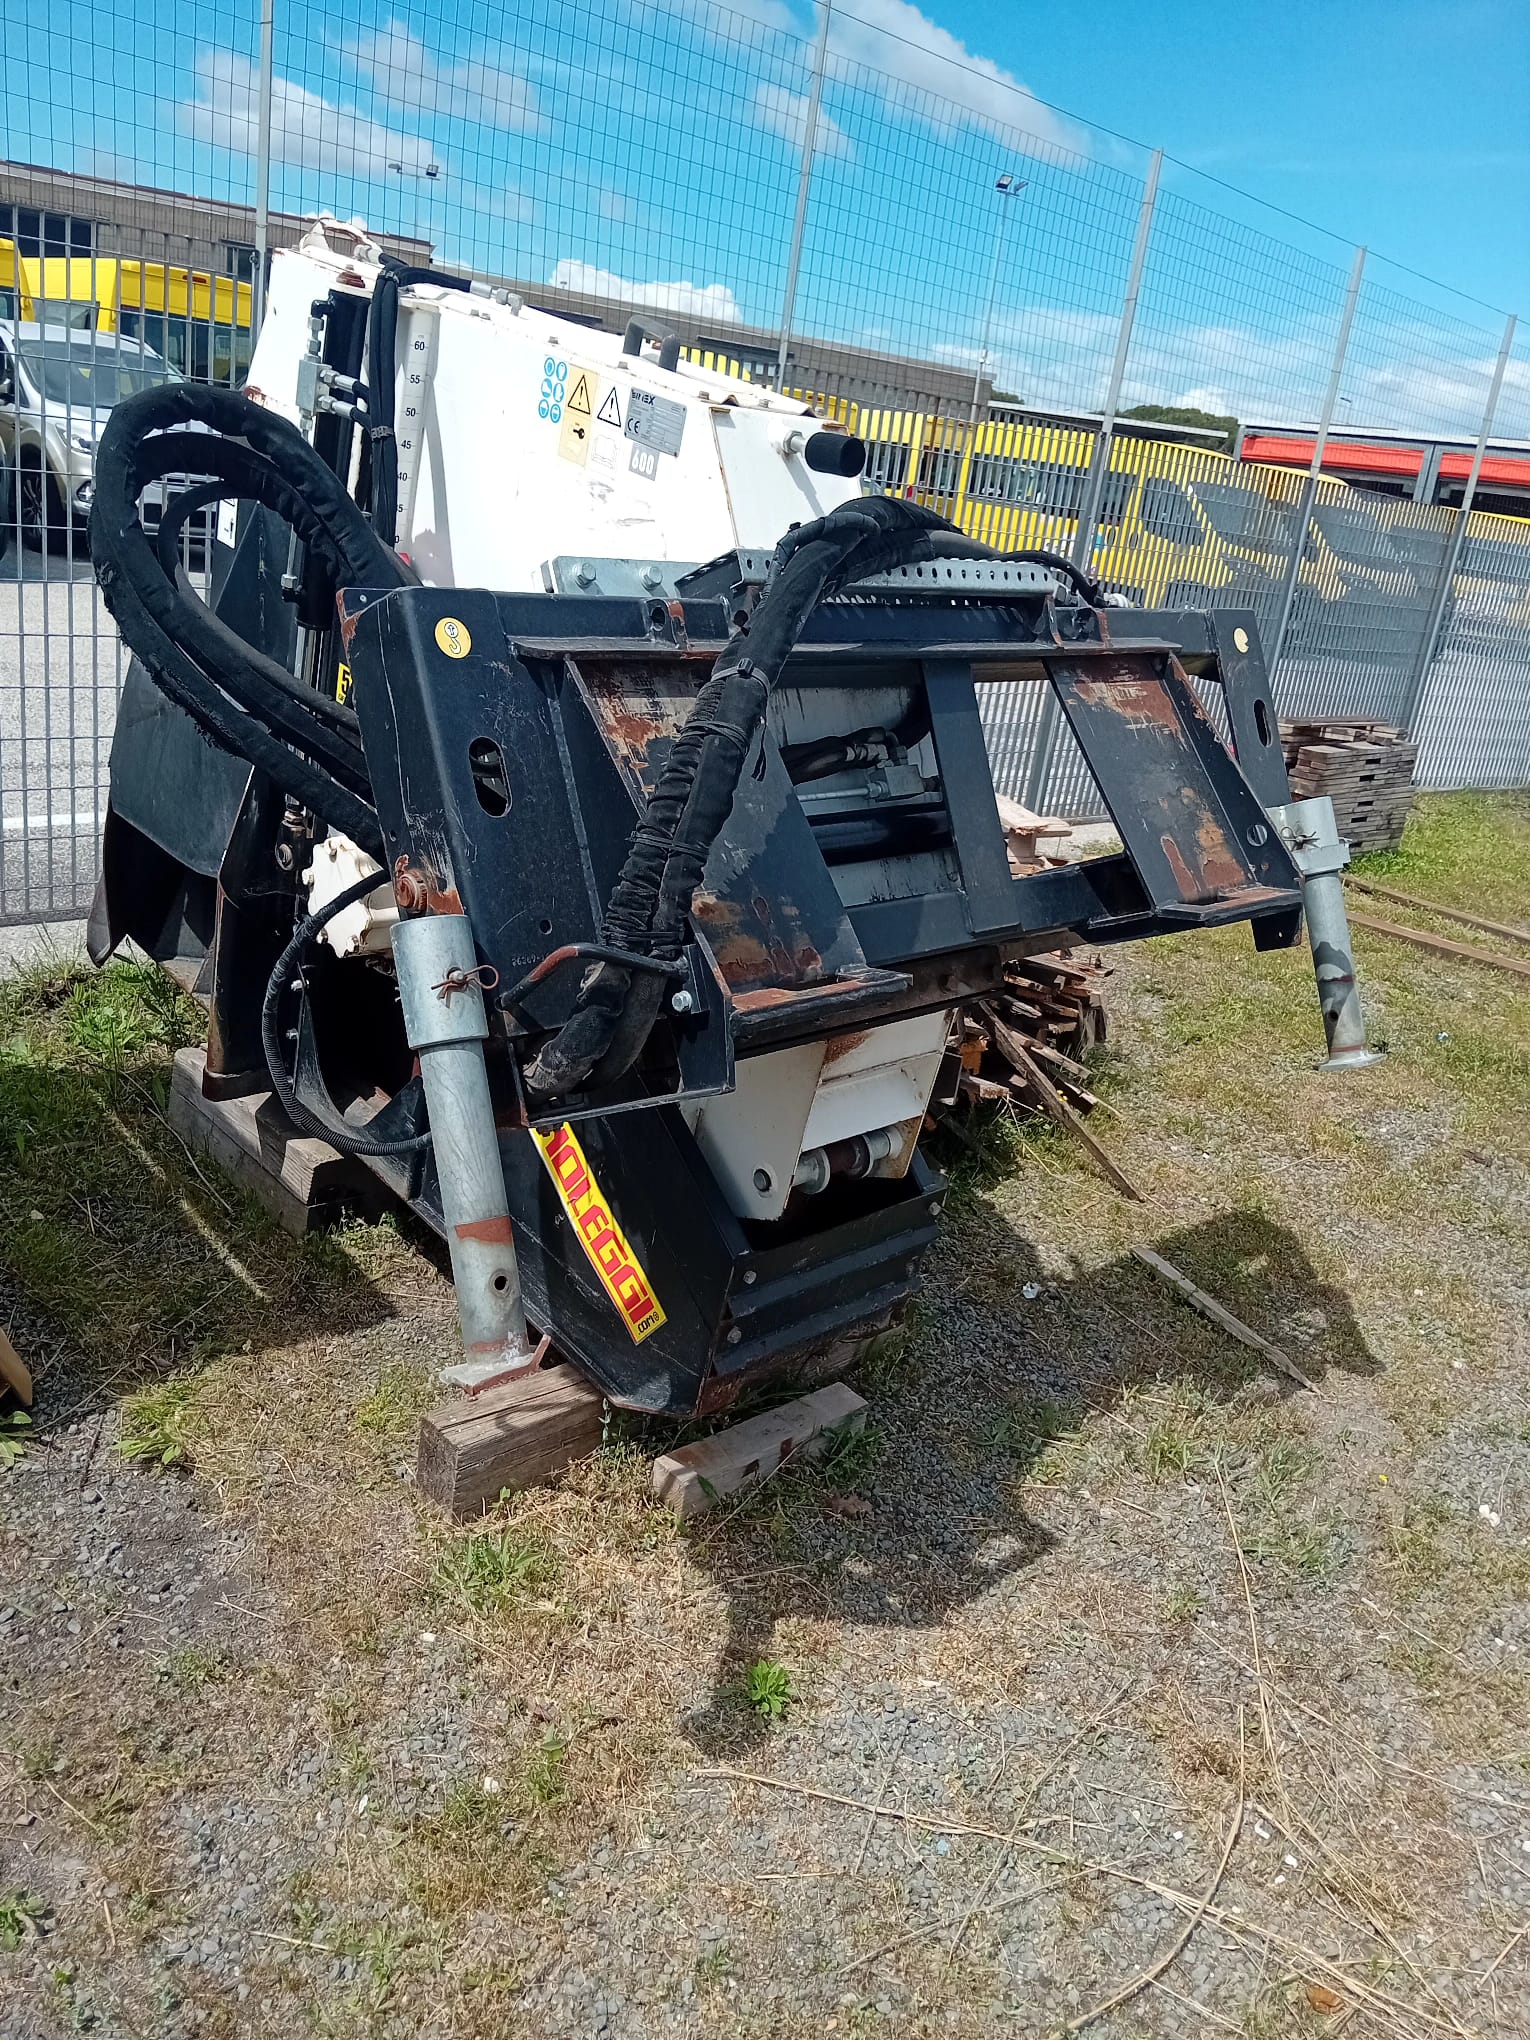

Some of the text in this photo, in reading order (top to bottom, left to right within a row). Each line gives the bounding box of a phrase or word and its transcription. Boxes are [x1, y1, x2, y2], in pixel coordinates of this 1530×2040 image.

[414, 341, 425, 350] 60
[410, 375, 420, 383] 55
[405, 408, 416, 416] 50
[627, 418, 640, 433] CE
[401, 440, 411, 449] 45
[631, 449, 655, 475] 600
